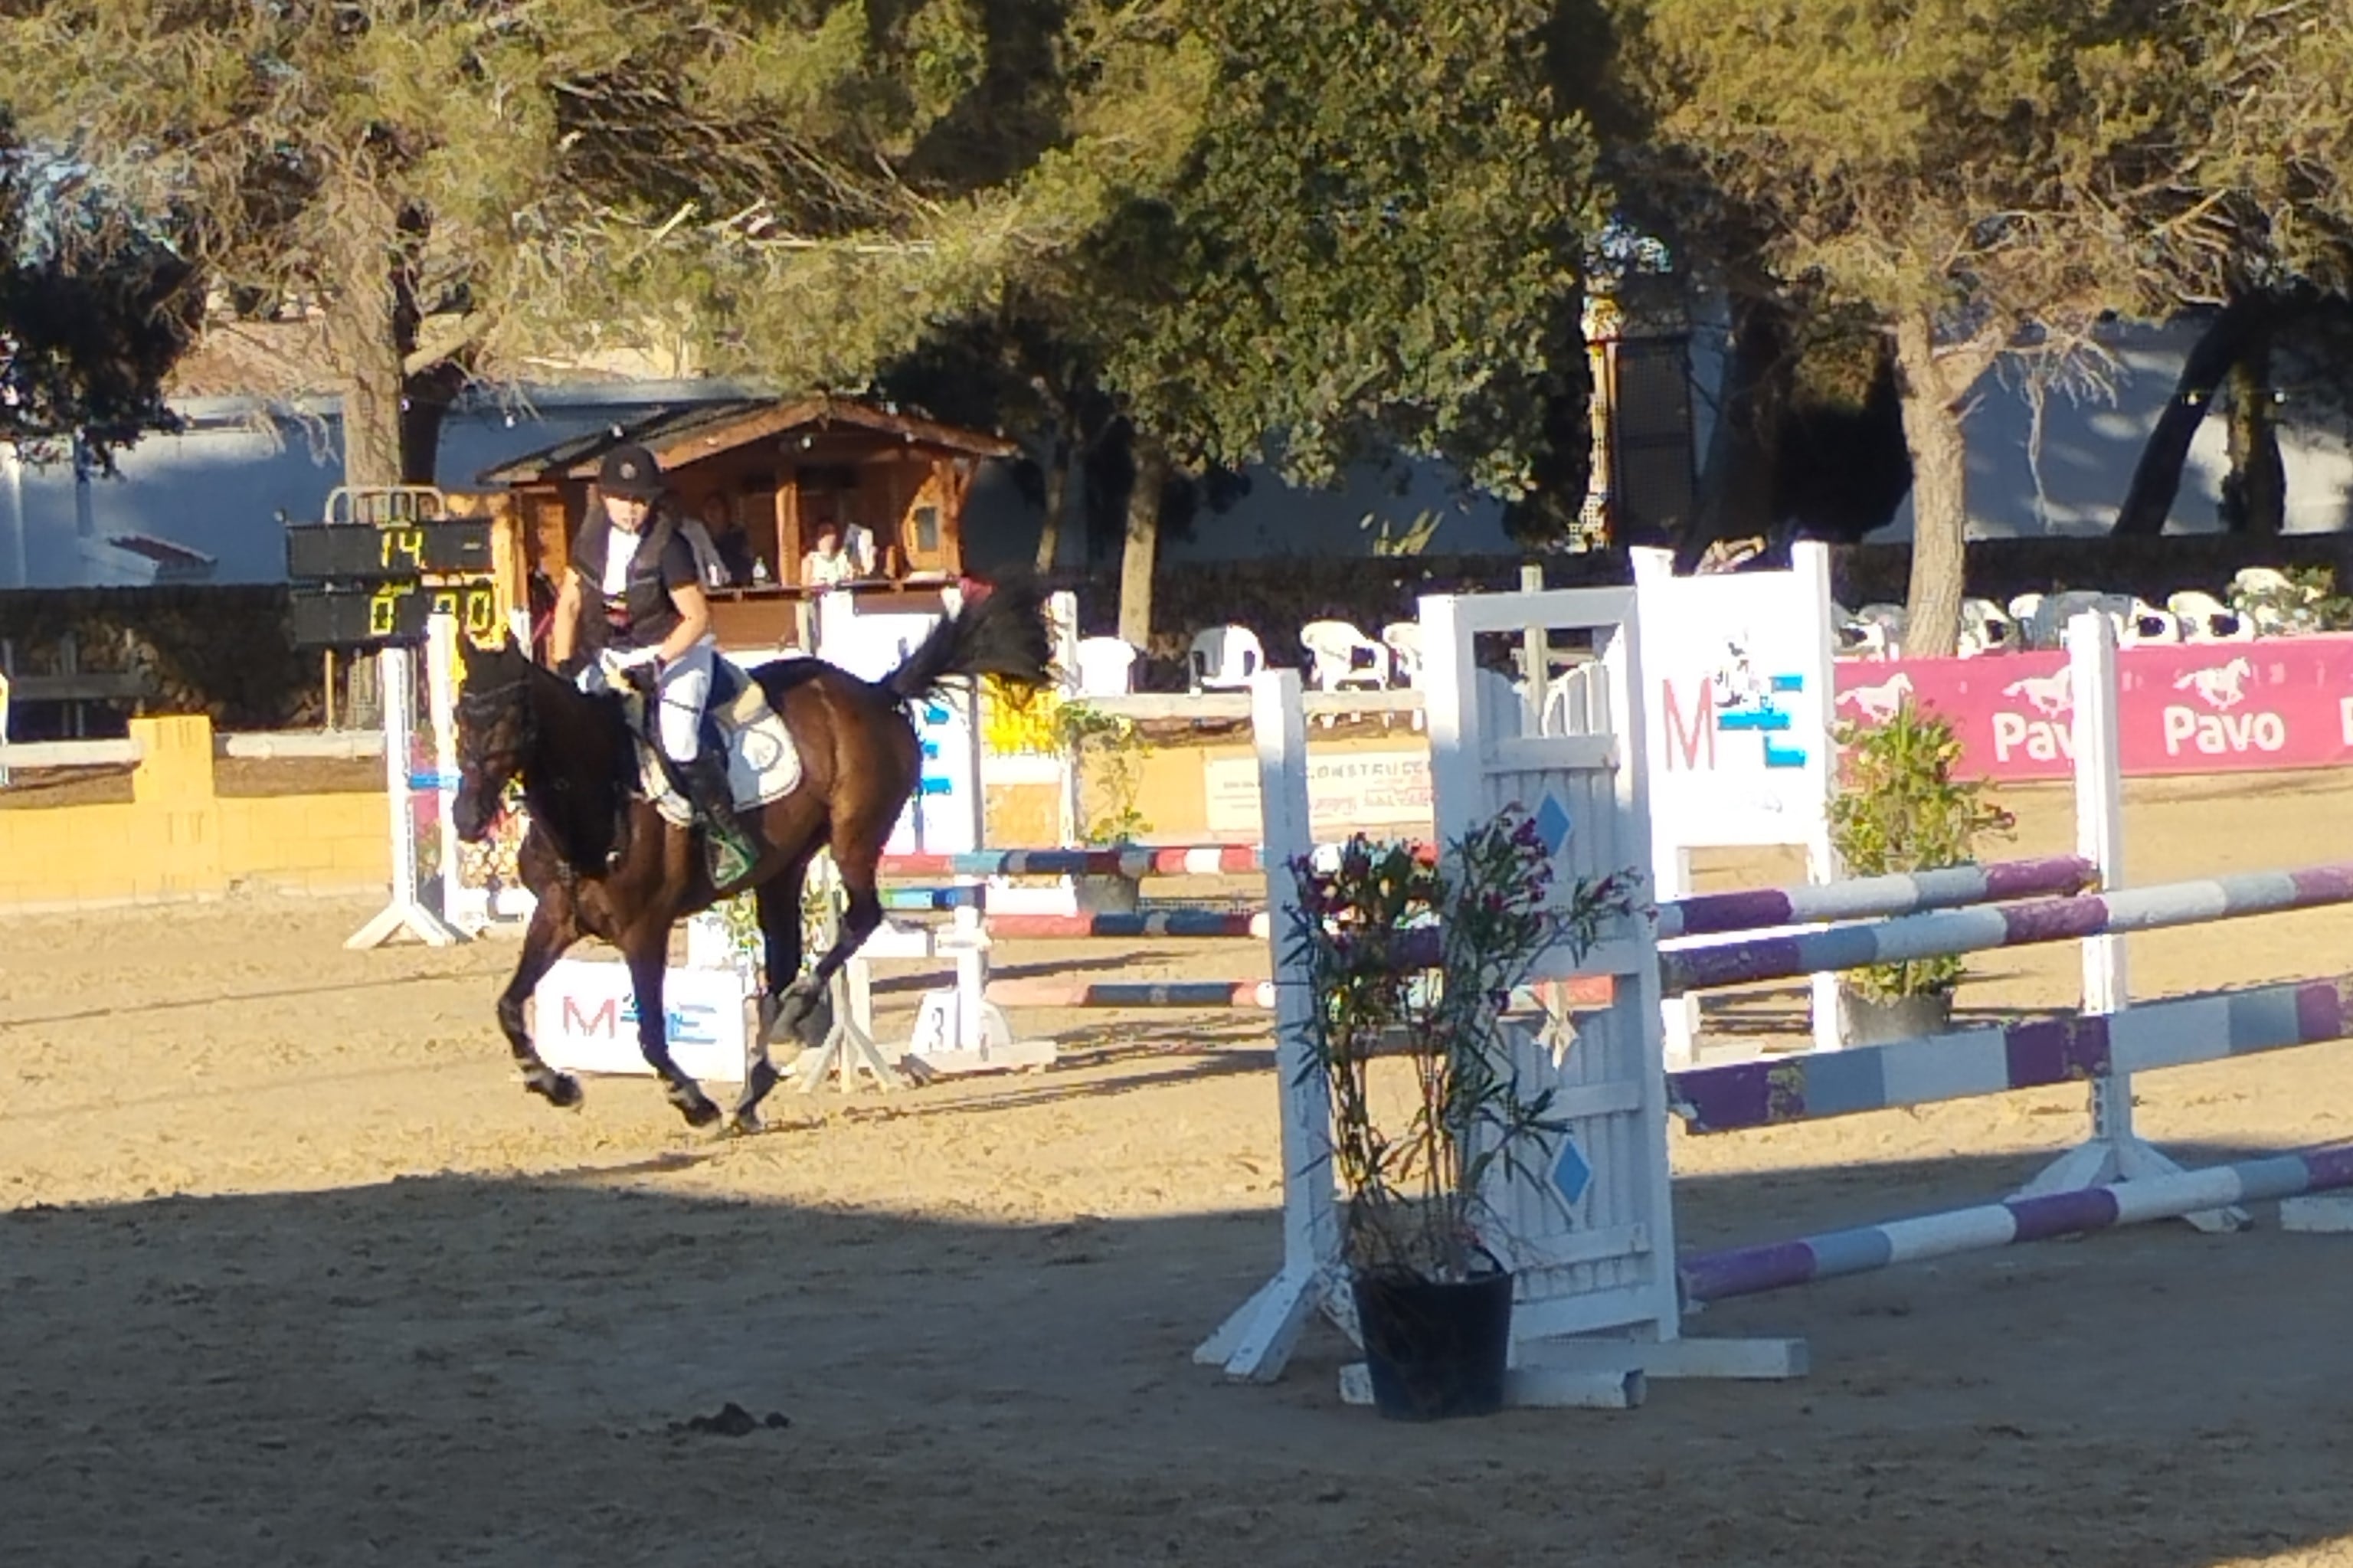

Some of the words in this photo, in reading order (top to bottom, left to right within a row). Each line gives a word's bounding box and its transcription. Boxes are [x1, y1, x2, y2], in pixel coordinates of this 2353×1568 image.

[381, 530, 423, 568] 14
[370, 596, 394, 635] 0
[1991, 711, 2074, 762] Pav
[2162, 705, 2286, 757] Pavo
